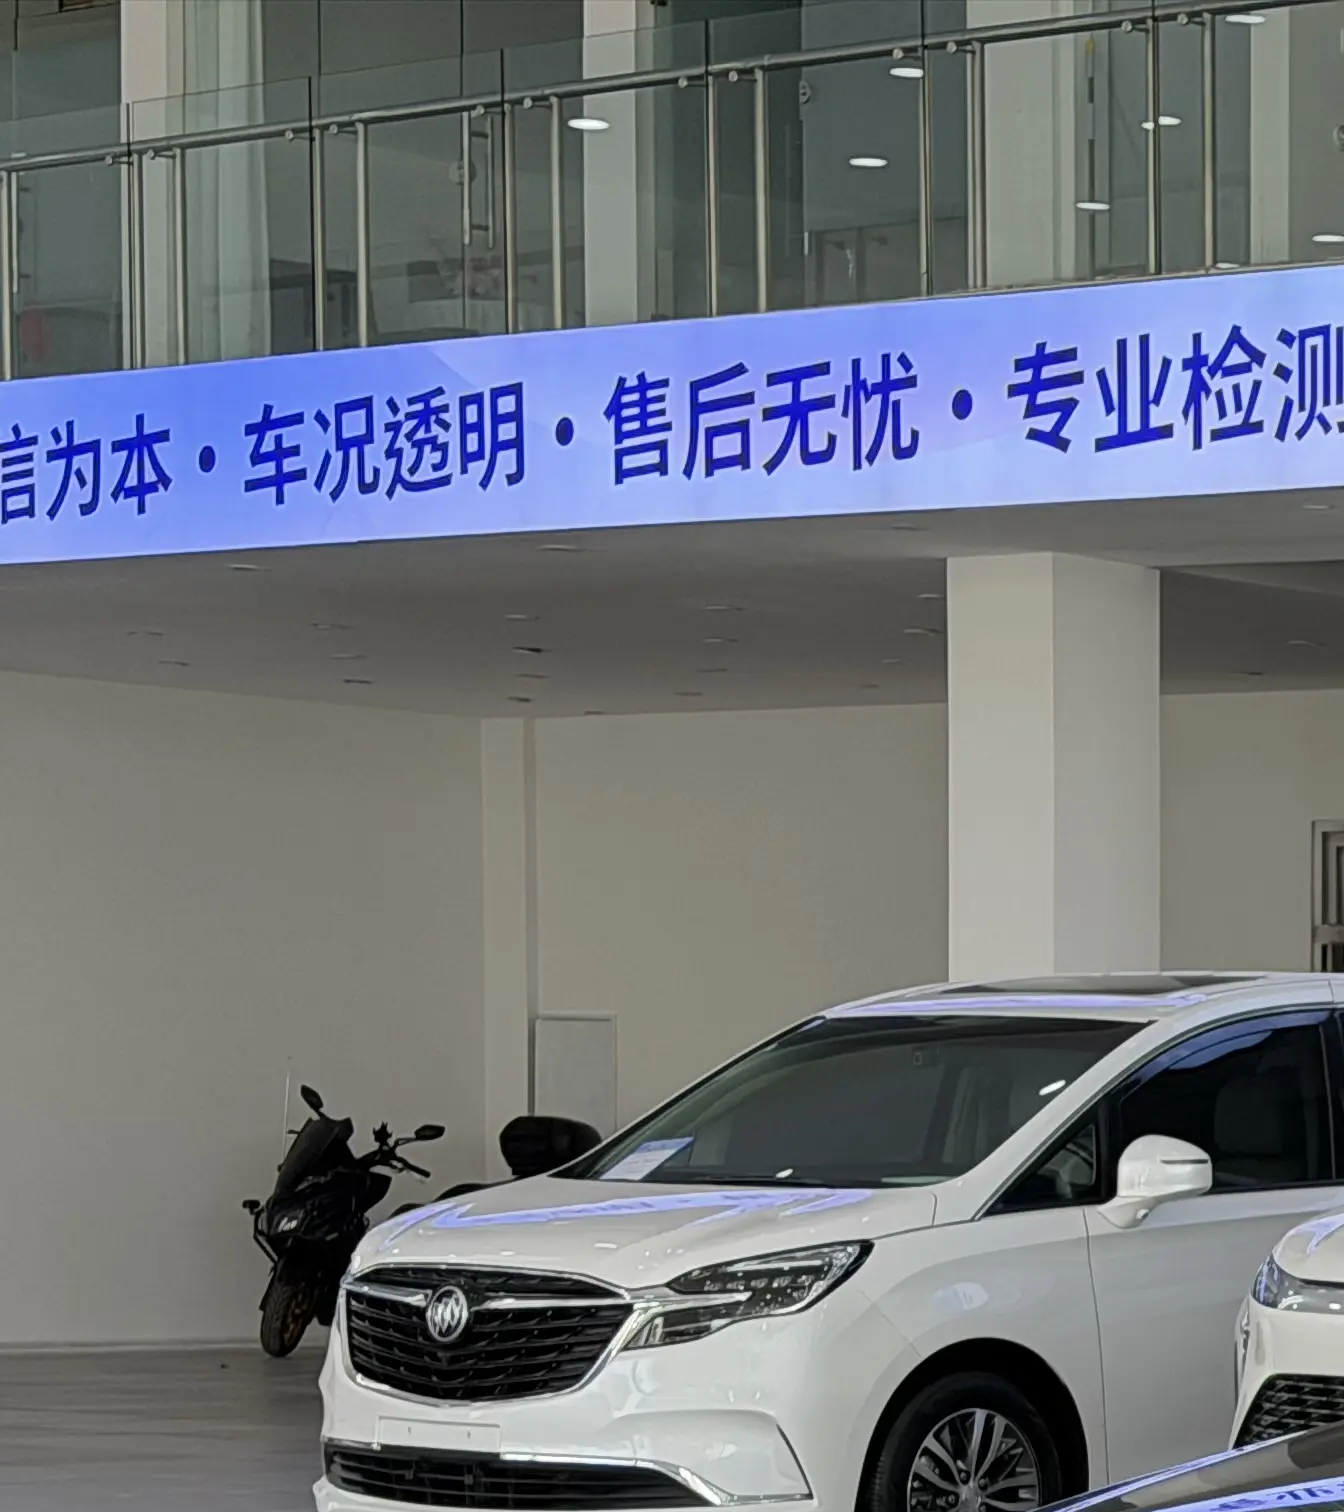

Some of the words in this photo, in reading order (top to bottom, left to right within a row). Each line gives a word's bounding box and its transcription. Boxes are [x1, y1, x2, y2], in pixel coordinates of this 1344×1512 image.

[0, 413, 173, 525] 信为本
[243, 381, 525, 507] 车况透明
[603, 351, 920, 487] 售后无忧
